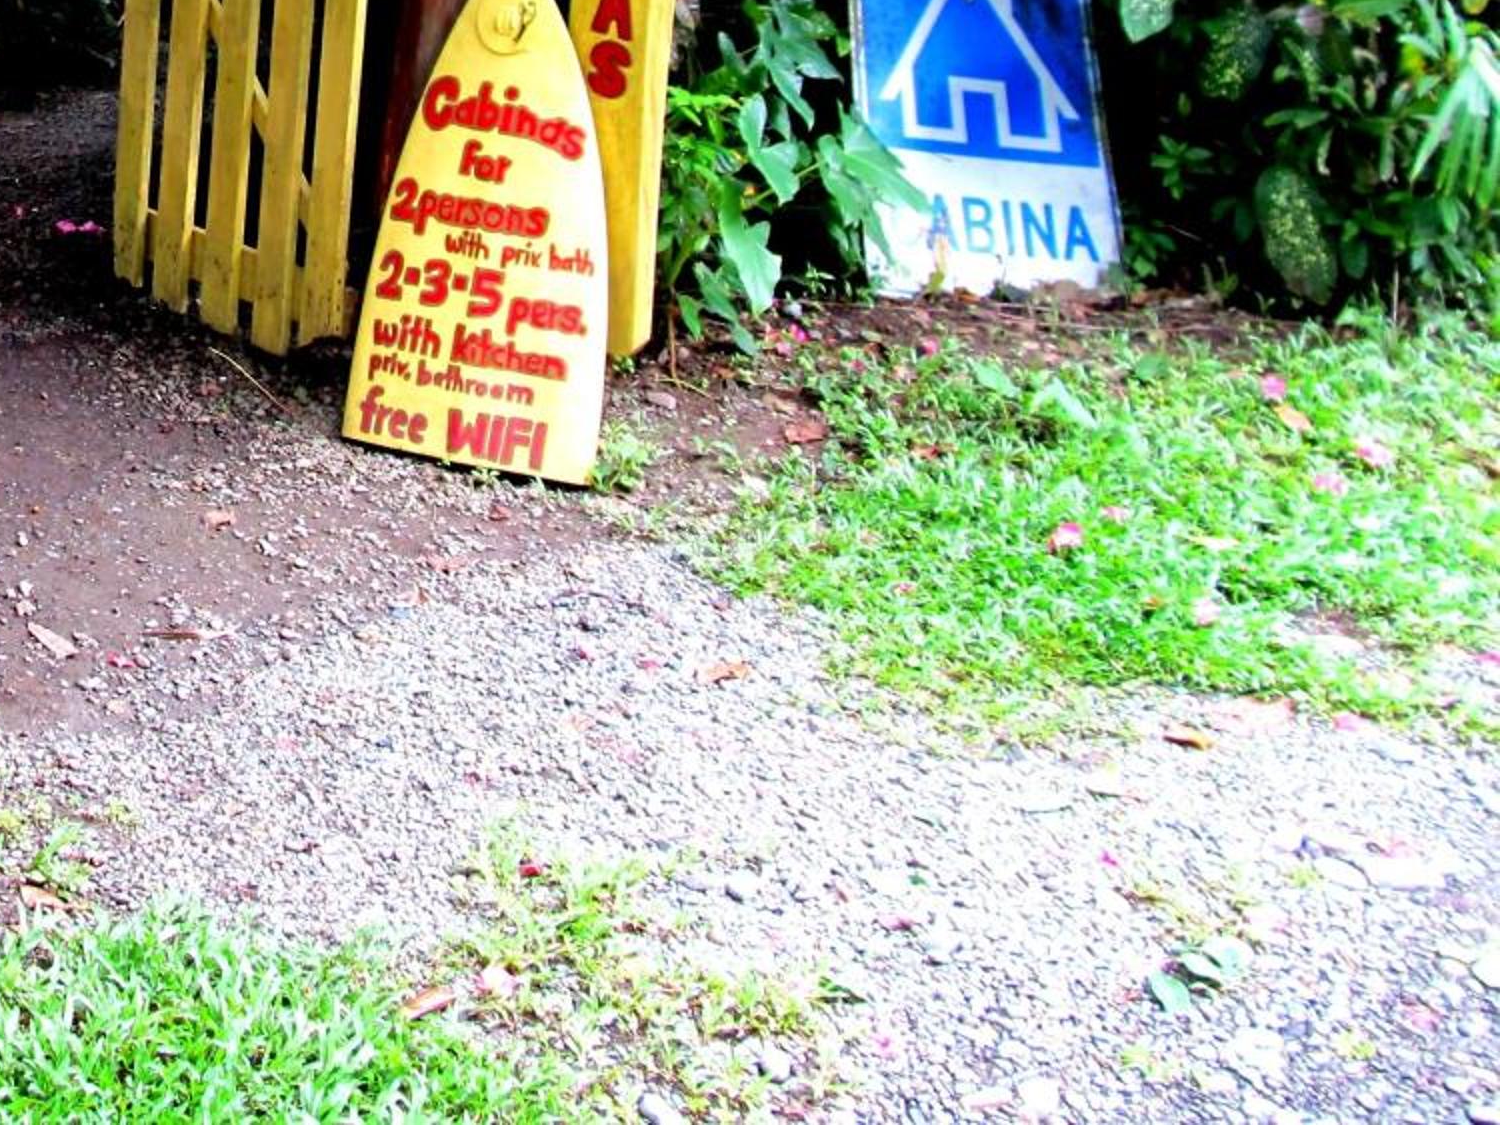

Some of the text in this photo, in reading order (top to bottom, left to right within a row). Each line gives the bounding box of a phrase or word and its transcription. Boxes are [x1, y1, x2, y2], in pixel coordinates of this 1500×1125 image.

[422, 74, 586, 161] Cabinas
[458, 138, 513, 184] for
[444, 230, 490, 260] with
[547, 243, 595, 277] bath
[926, 192, 1100, 263] ABINA
[505, 295, 588, 336] pers.
[372, 313, 569, 382] with kitchen
[415, 359, 535, 407] bathroom
[359, 384, 549, 472] free WIFI
